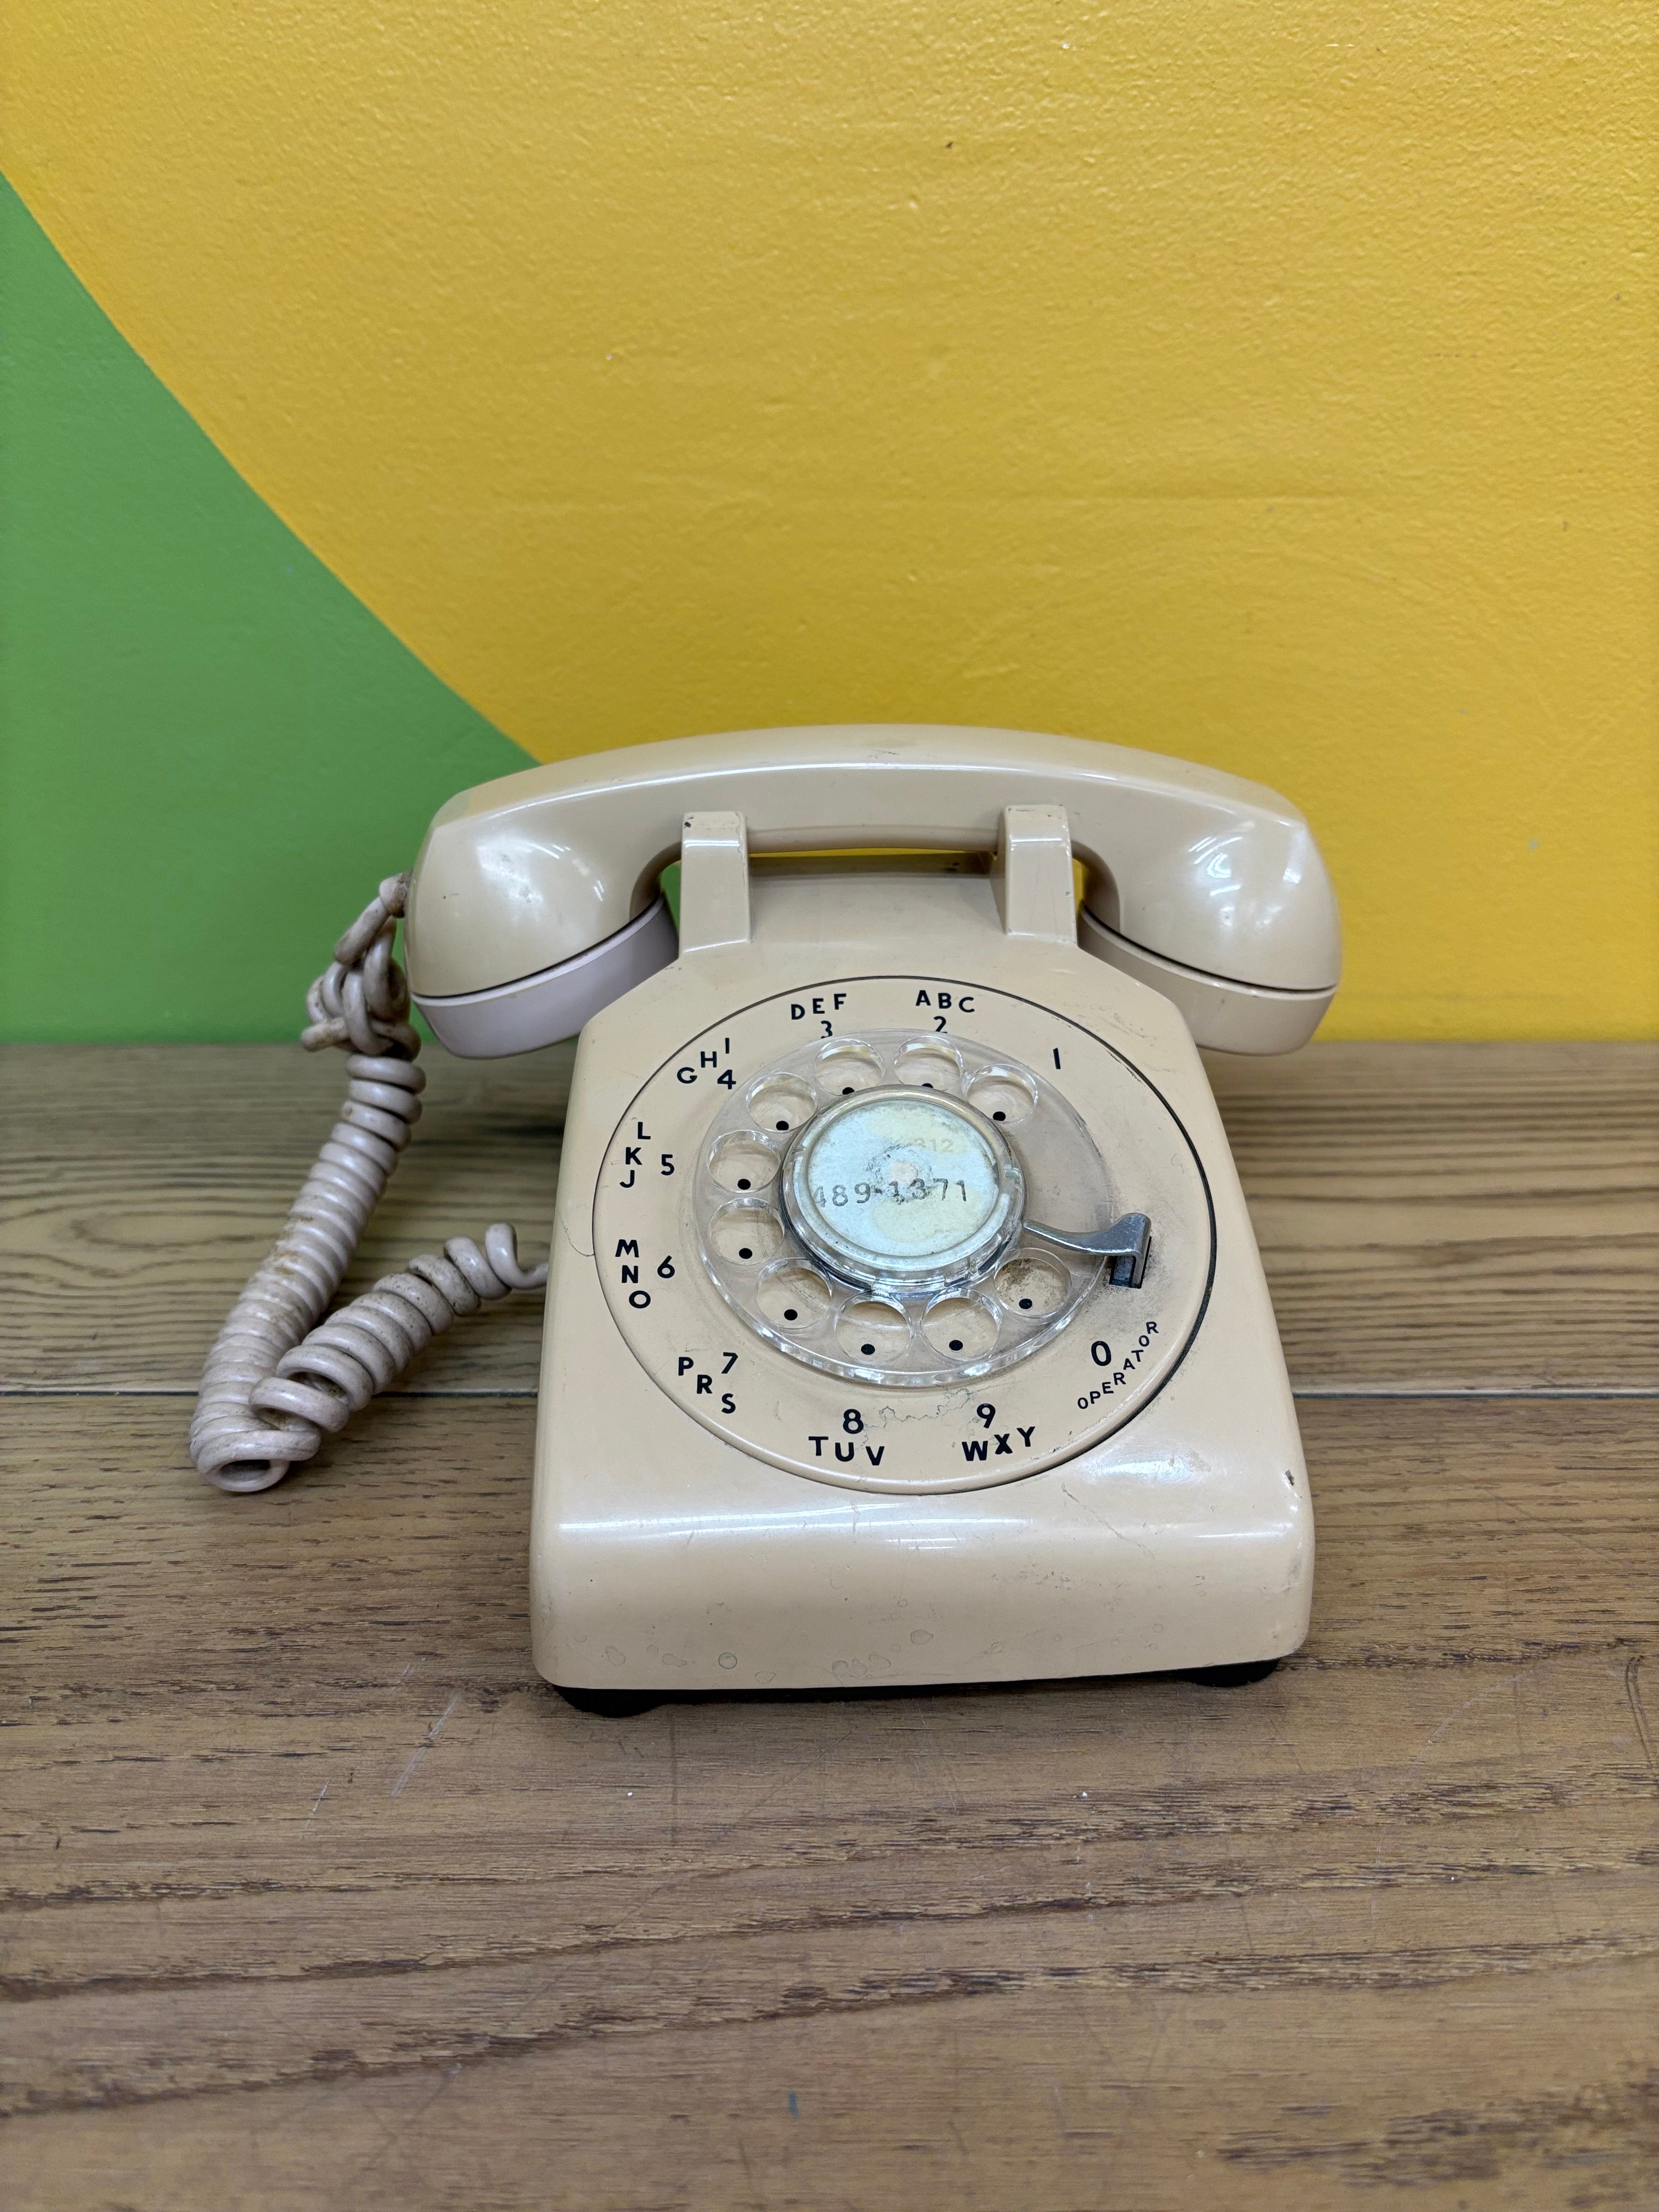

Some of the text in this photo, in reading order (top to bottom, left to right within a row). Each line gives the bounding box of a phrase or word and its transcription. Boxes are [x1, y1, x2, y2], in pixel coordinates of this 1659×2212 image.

[791, 993, 847, 1020] DEF
[916, 990, 975, 1013] ABC
[820, 1020, 833, 1039] 3
[933, 1016, 947, 1034] 2
[676, 1037, 730, 1084] GHI
[717, 1069, 737, 1090] 4
[661, 1154, 675, 1176] 5
[615, 1239, 651, 1309] MNO
[657, 1255, 675, 1279] 6
[721, 1352, 738, 1374] 7
[1077, 1321, 1159, 1409] OPERATOR
[678, 1356, 736, 1414] PRS
[842, 1408, 864, 1435] 8
[977, 1403, 996, 1429] 9
[808, 1436, 885, 1466] TUV
[961, 1426, 1036, 1462] WXY
